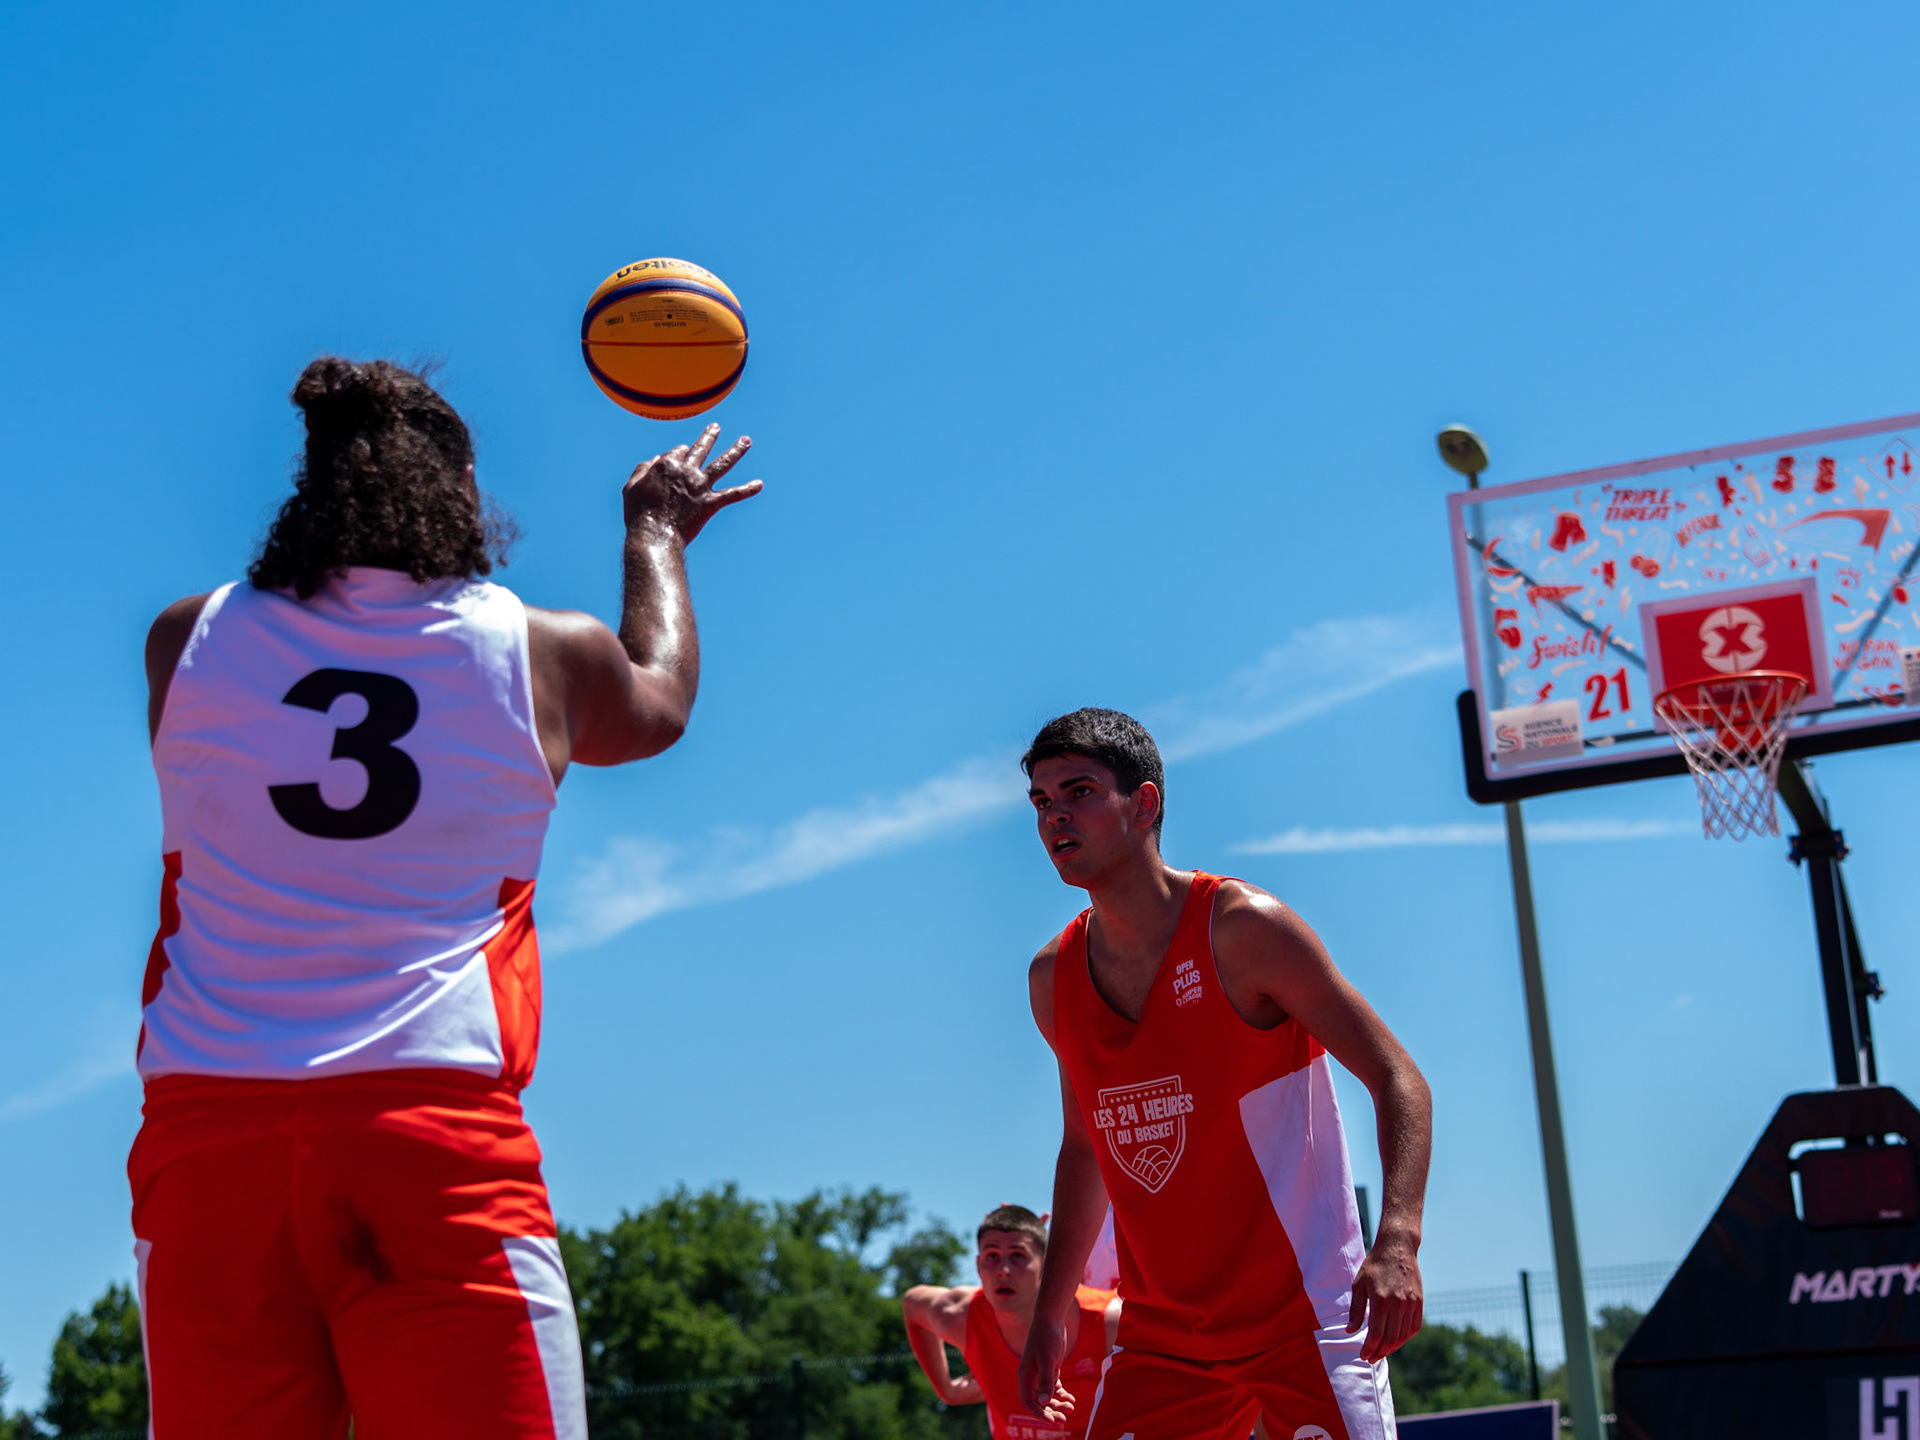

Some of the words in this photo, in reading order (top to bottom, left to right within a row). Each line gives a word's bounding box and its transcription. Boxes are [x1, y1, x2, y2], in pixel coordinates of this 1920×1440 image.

[1527, 623, 1614, 670] Swish!
[1584, 666, 1632, 723] 21
[1524, 724, 1579, 739] NATIONALE
[268, 667, 421, 840] 3
[1173, 970, 1201, 995] PLUS
[1176, 960, 1194, 975] OPEN
[1182, 986, 1203, 999] SUPER
[1093, 1107, 1116, 1129] LES
[1117, 1103, 1139, 1126] 24
[1142, 1093, 1194, 1122] HEURES
[1117, 1129, 1132, 1145] DU
[1135, 1121, 1175, 1143] BASKET
[1789, 1263, 1920, 1304] MARTY
